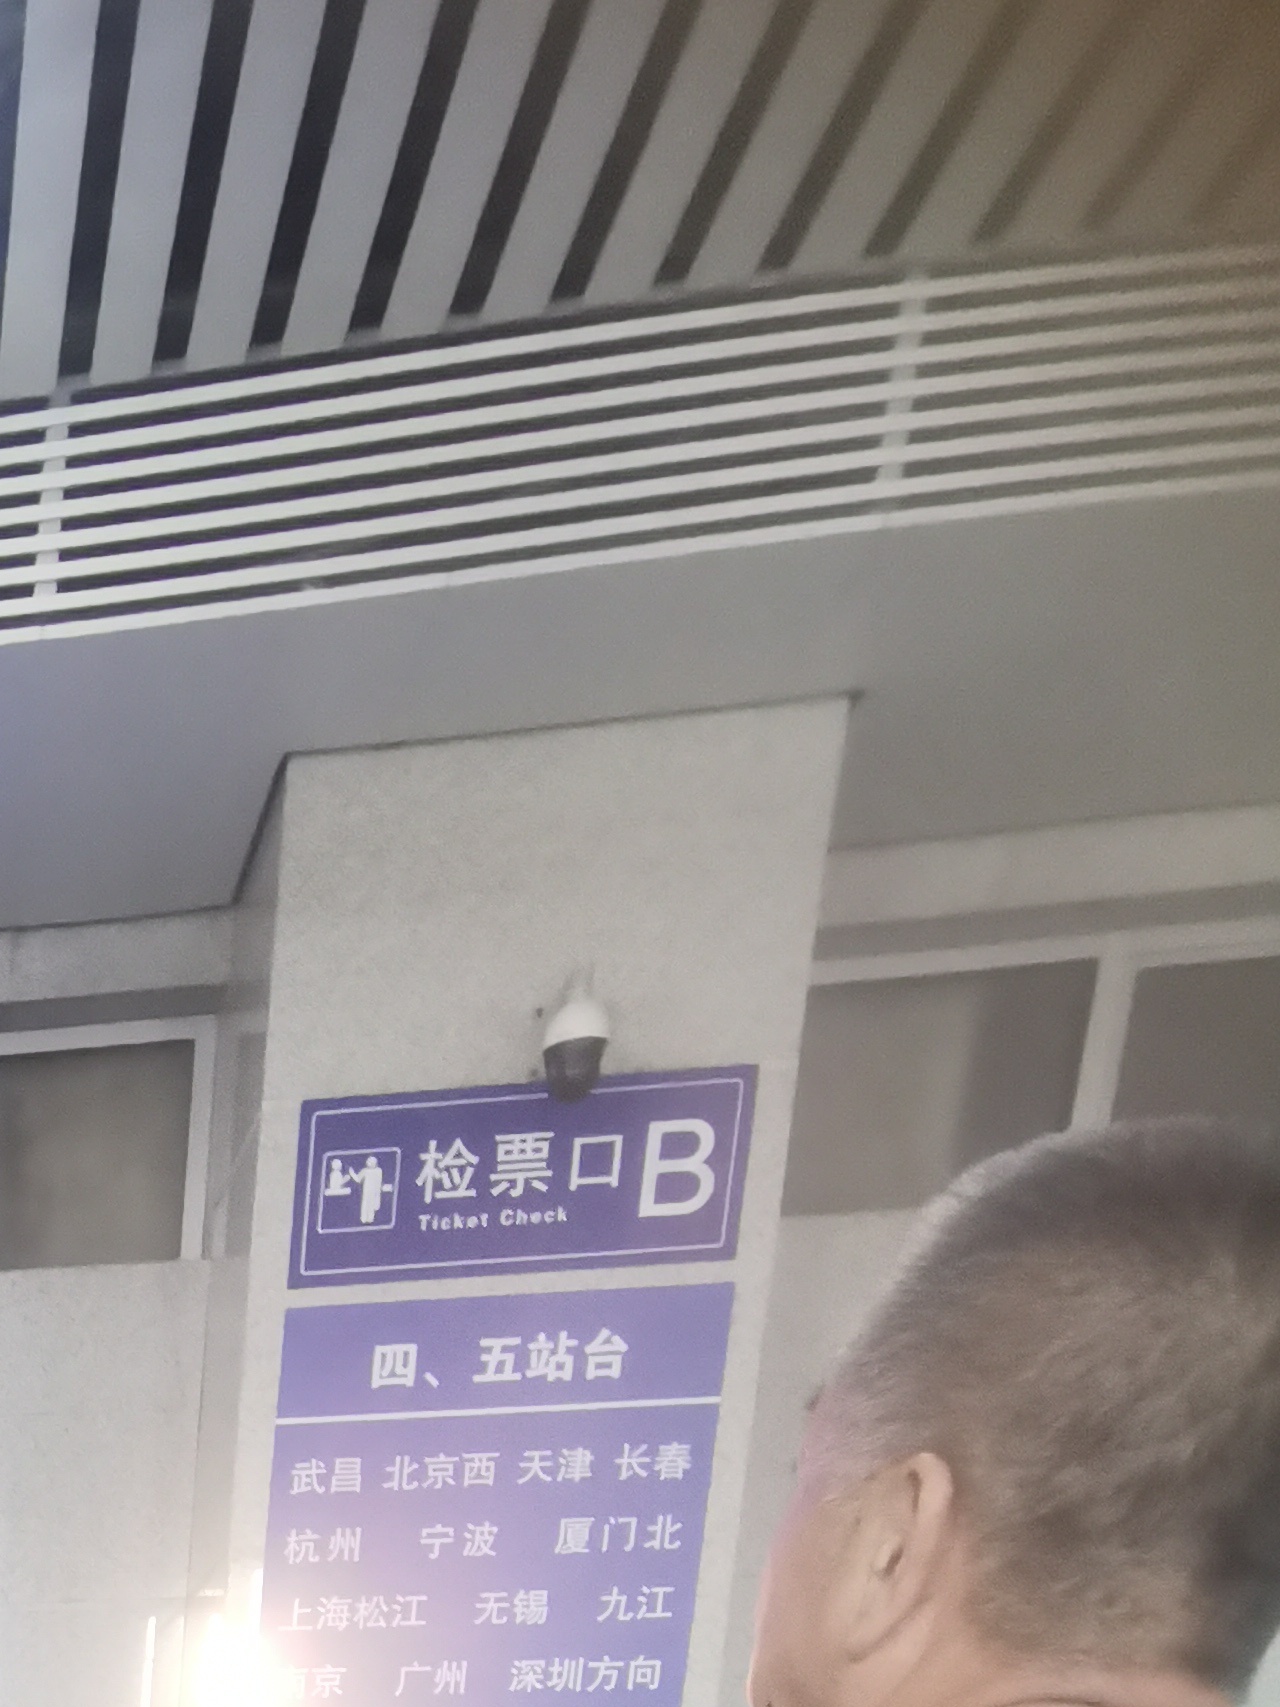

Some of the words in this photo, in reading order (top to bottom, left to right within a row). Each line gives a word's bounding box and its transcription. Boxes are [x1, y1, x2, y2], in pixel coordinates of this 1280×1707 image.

[415, 1130, 625, 1205] 检票口
[638, 1117, 718, 1219] B
[418, 1210, 490, 1231] Ticket
[500, 1206, 568, 1226] Check
[371, 1328, 629, 1389] 四、五站台
[288, 1457, 363, 1495] 武昌
[382, 1450, 501, 1492] 北京西
[516, 1446, 594, 1485] 天津
[613, 1441, 693, 1482] 长春
[283, 1526, 363, 1564] 杭州
[419, 1522, 500, 1560] 宁波
[554, 1514, 683, 1555] 厦门北
[277, 1594, 428, 1632] 上海松江
[473, 1587, 550, 1626] 无锡
[595, 1584, 675, 1623] 九江
[394, 1659, 468, 1697] 广州
[508, 1654, 662, 1694] 深圳方向
